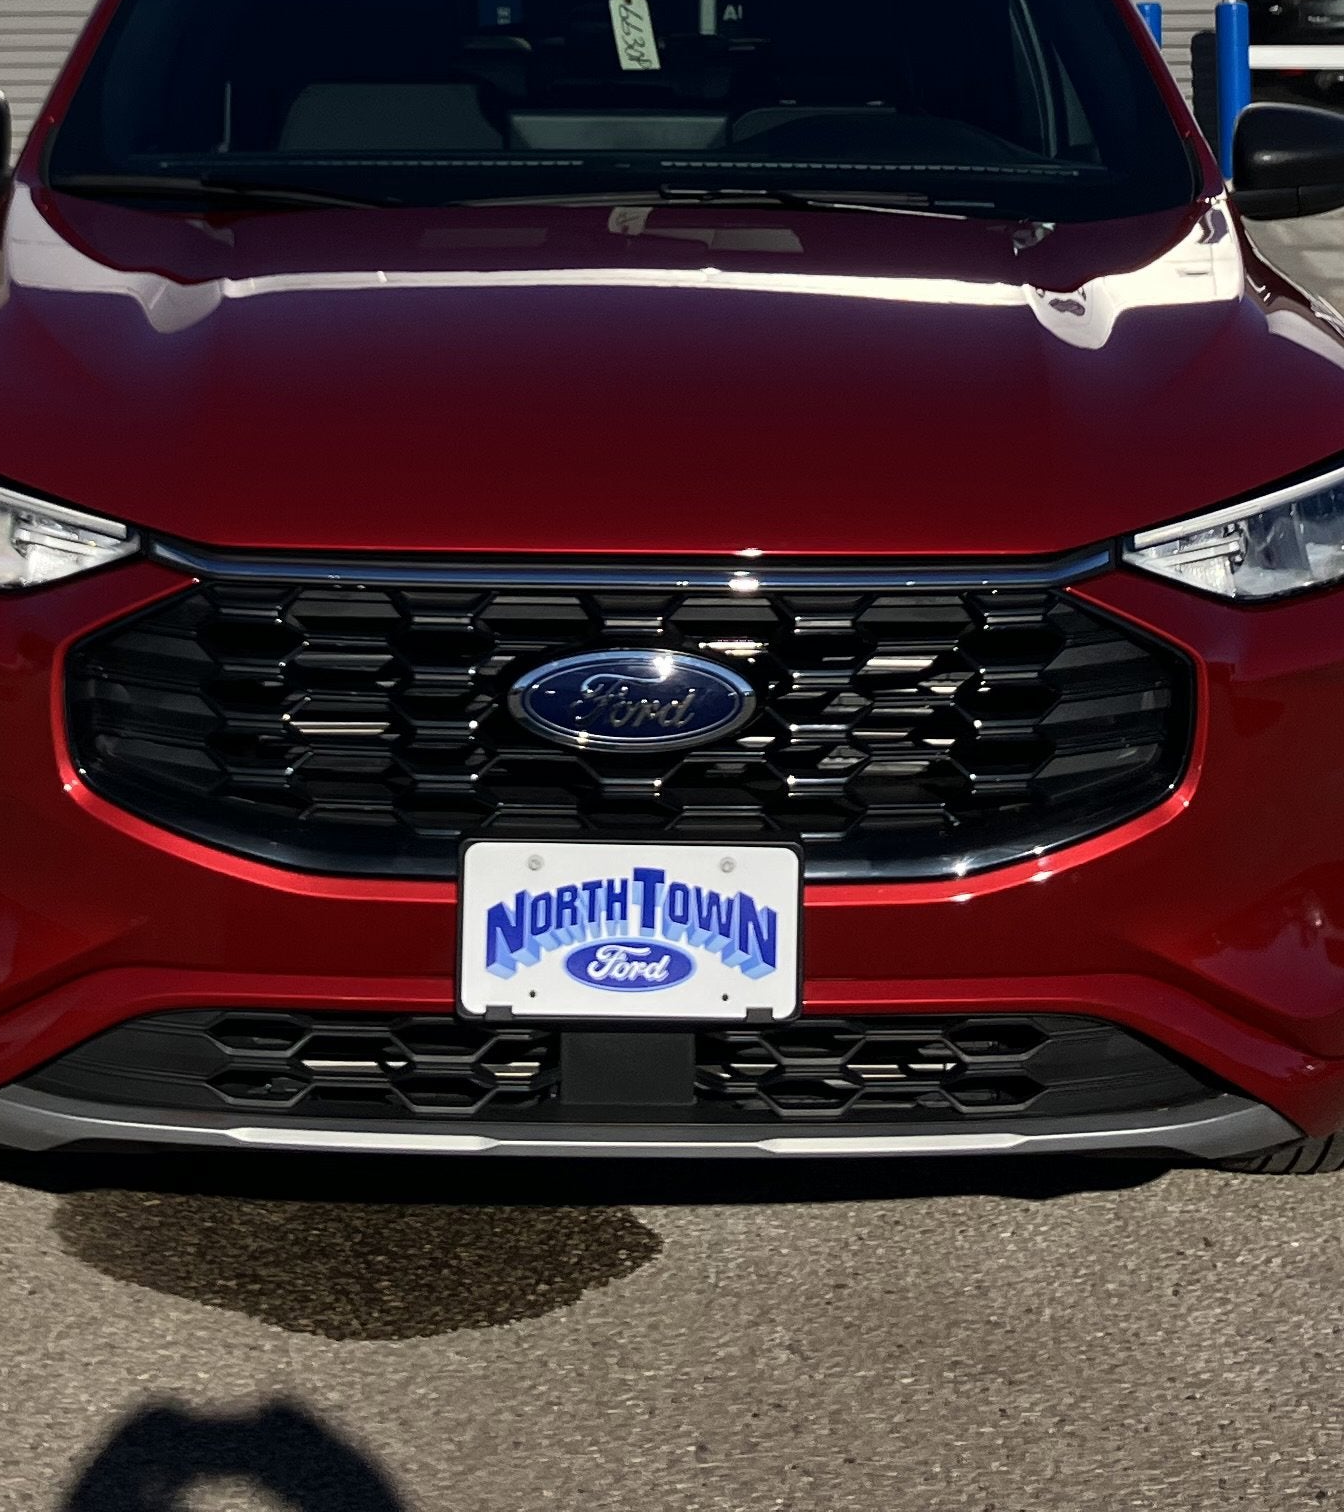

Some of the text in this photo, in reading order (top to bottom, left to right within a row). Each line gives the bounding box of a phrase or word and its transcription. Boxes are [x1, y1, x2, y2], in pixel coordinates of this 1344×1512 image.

[570, 673, 696, 728] Ford
[485, 867, 777, 972] NORTHTOWN
[585, 943, 670, 982] Ford
